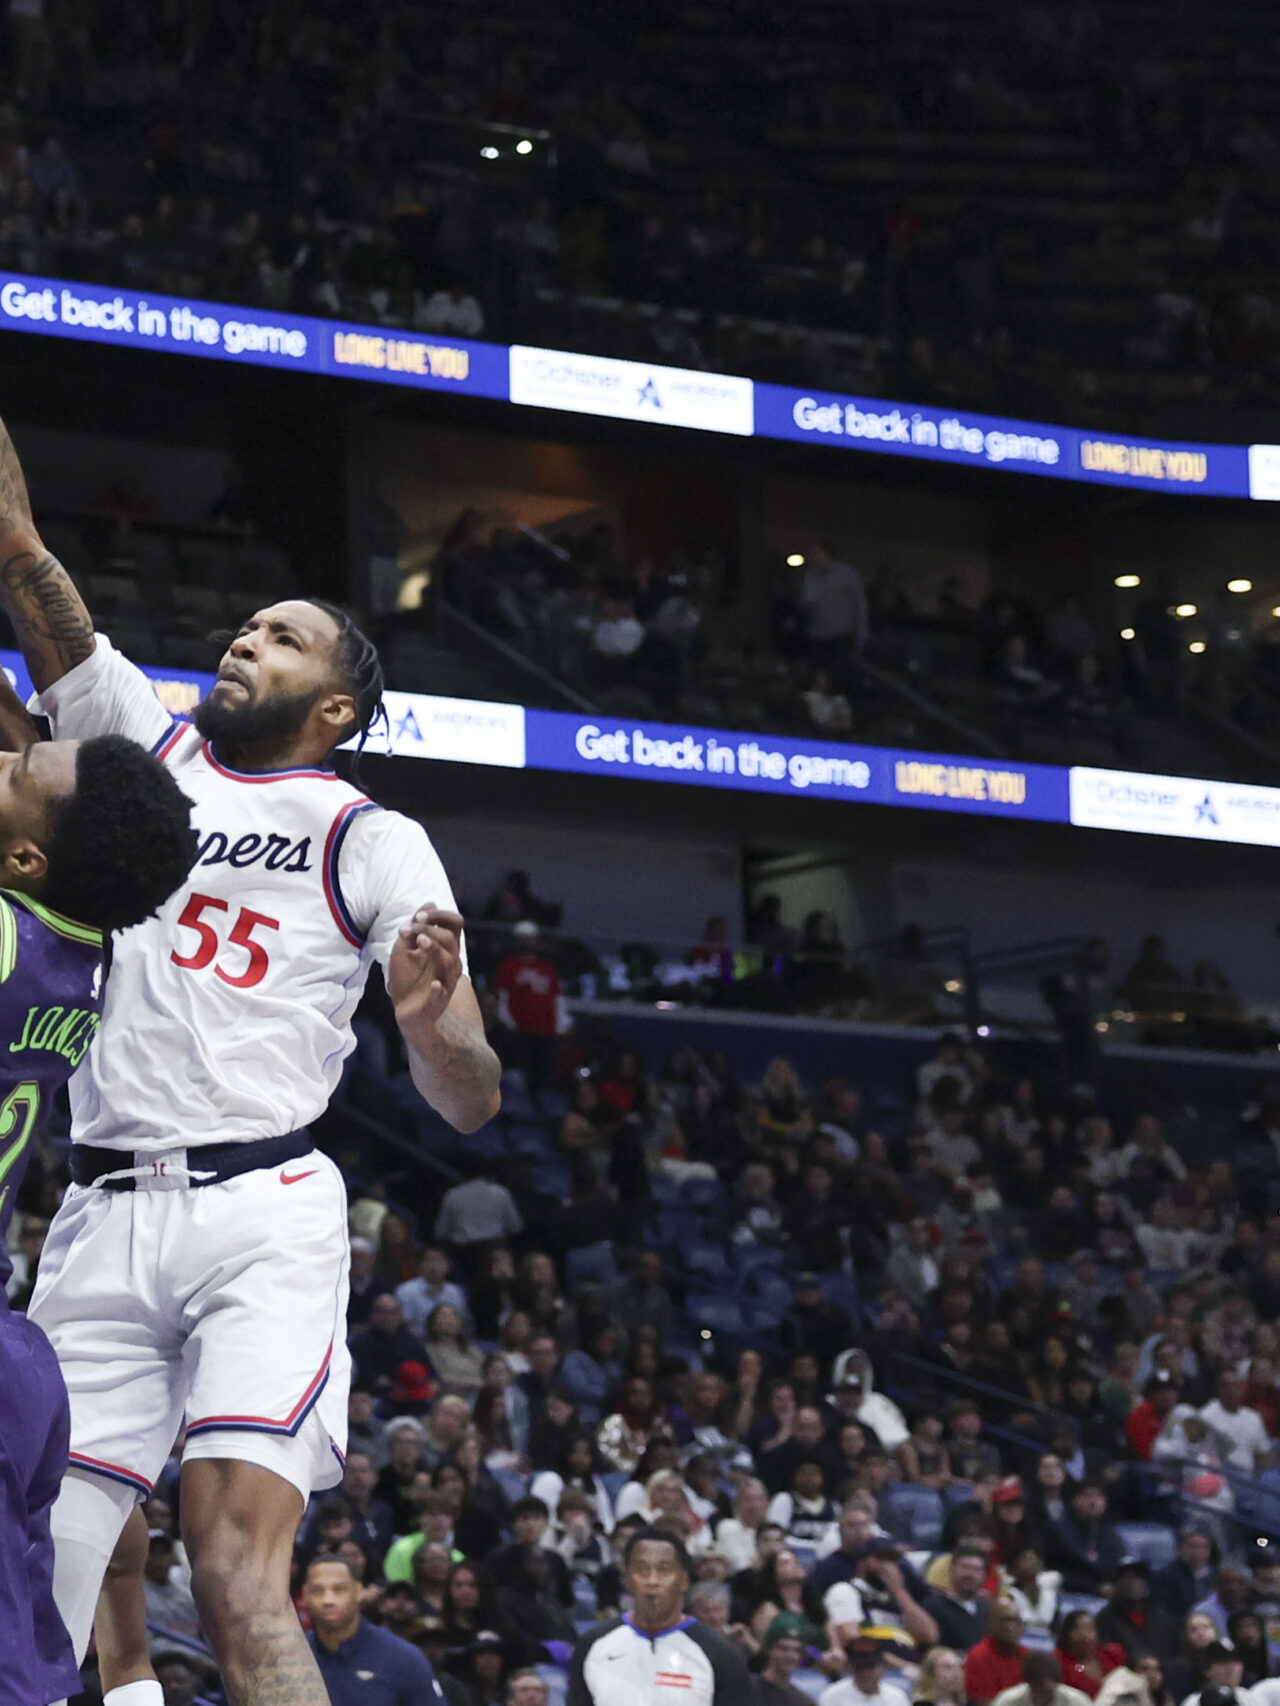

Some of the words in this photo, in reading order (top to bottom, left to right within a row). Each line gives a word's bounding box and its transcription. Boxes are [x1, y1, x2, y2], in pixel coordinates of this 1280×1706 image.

[1, 282, 58, 322] Get
[61, 289, 134, 333] back
[138, 300, 167, 338] in
[170, 306, 220, 345] the
[222, 320, 307, 358] game
[334, 331, 385, 368] LONG
[386, 339, 428, 375] LIVE
[428, 345, 469, 381] YOU
[792, 397, 843, 434] Get
[844, 403, 910, 443] back
[911, 413, 938, 447] in
[939, 418, 984, 454] the
[984, 431, 1059, 465] game
[1080, 440, 1130, 474] LONG
[1165, 451, 1207, 482] YOU
[575, 724, 630, 763] Get
[632, 729, 704, 771] back
[706, 737, 735, 774] in
[737, 742, 787, 780] the
[788, 754, 870, 789] game
[895, 760, 946, 796] LONG
[946, 765, 987, 800] LIVE
[986, 770, 1026, 804] YOU
[187, 829, 313, 876] pers
[169, 892, 280, 988] 55
[9, 1006, 102, 1068] JONES
